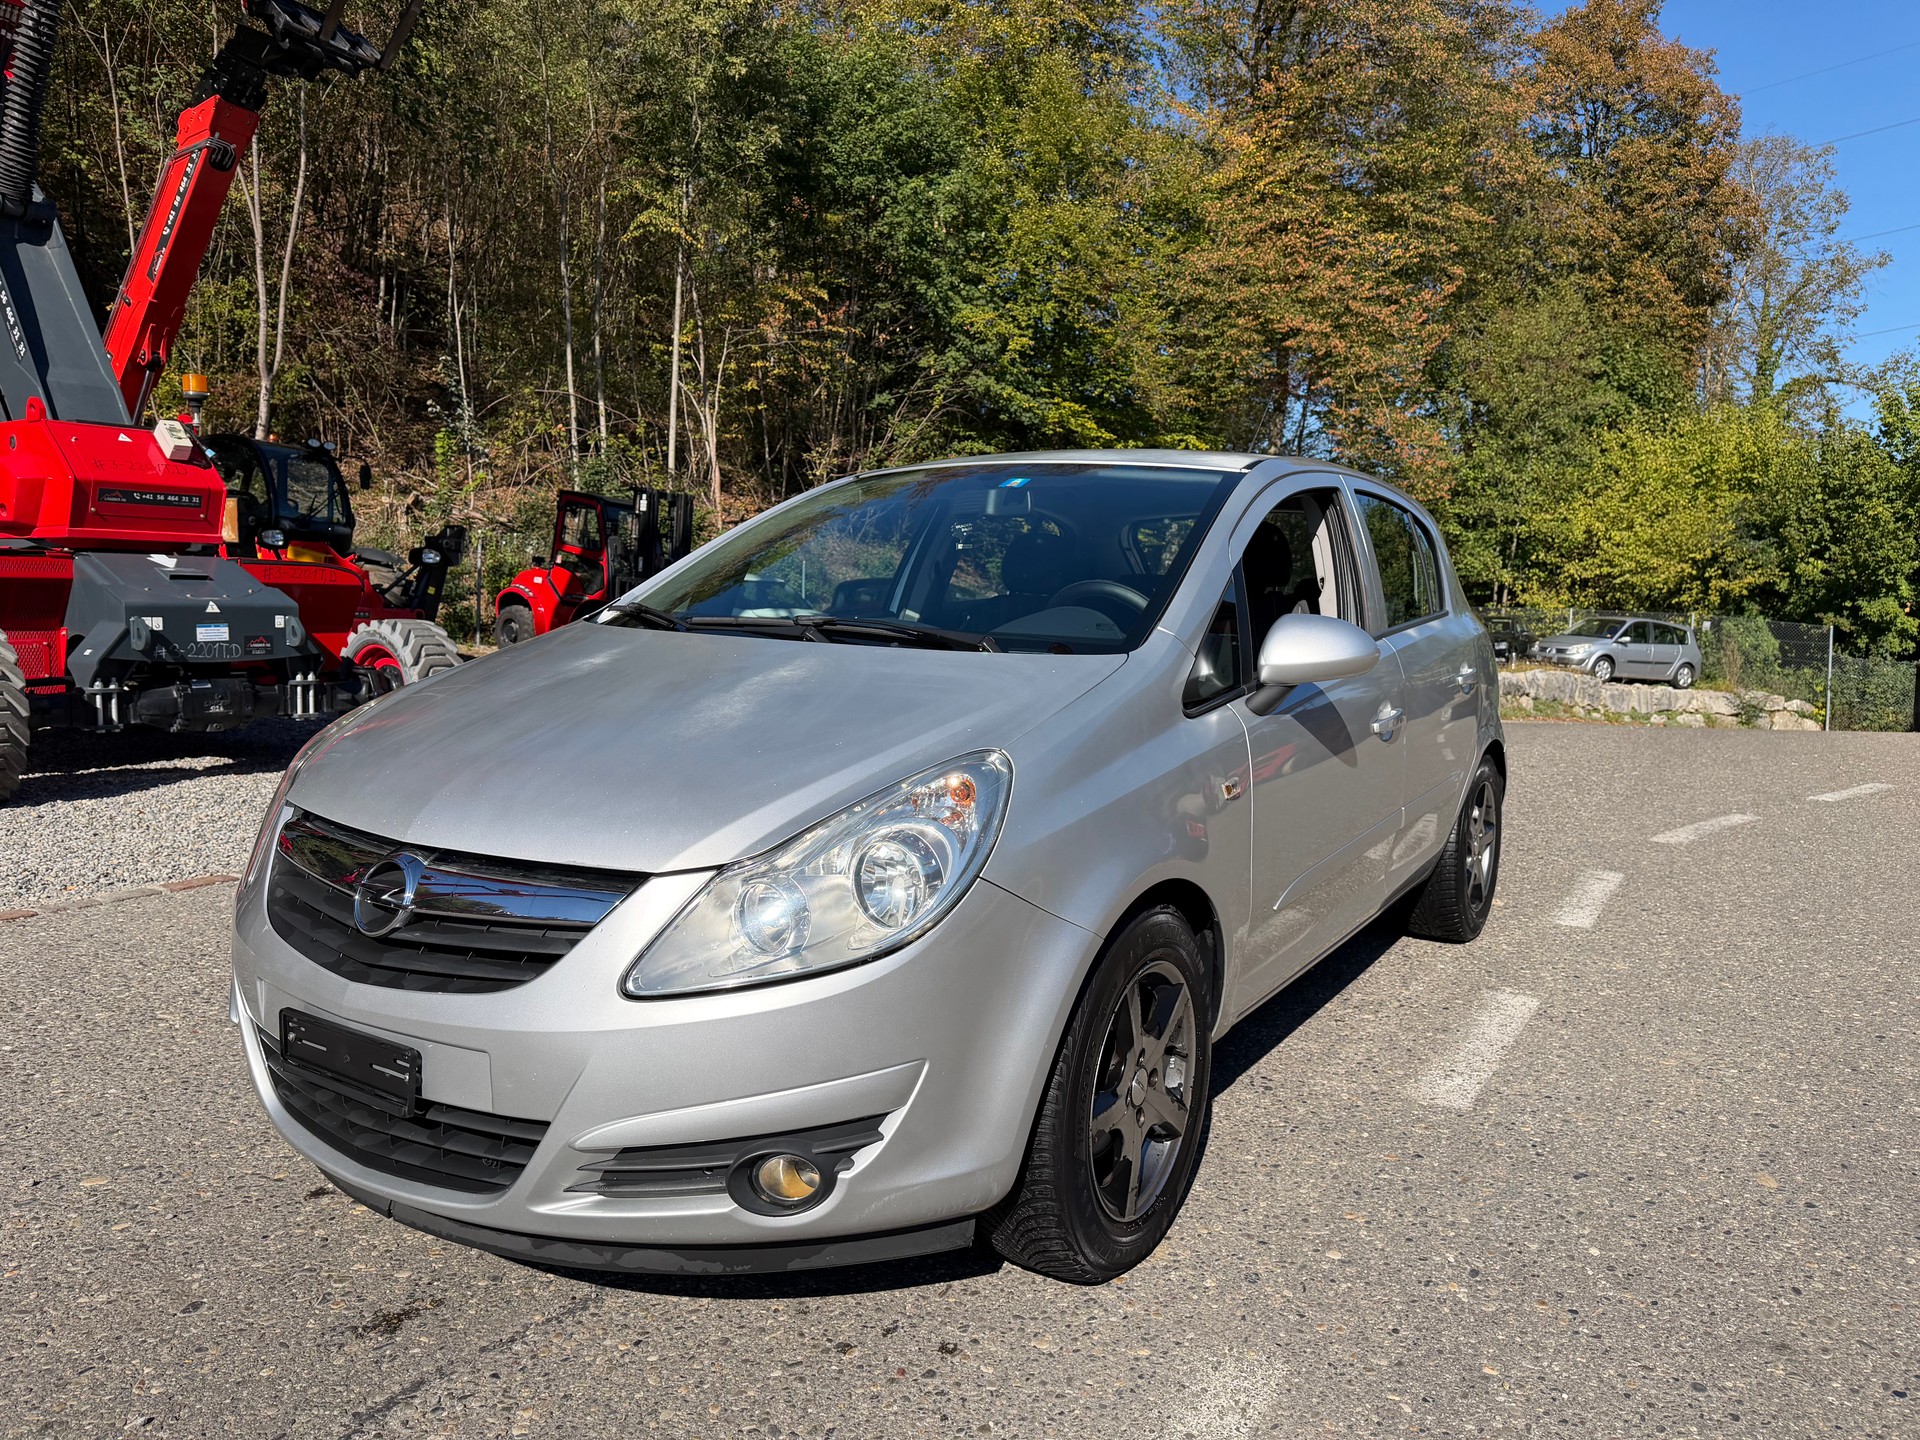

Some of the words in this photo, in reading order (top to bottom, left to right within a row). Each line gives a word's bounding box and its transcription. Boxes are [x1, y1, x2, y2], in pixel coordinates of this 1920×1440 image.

[5, 306, 15, 325] 464
[13, 325, 20, 341] 31
[18, 341, 26, 357] 31
